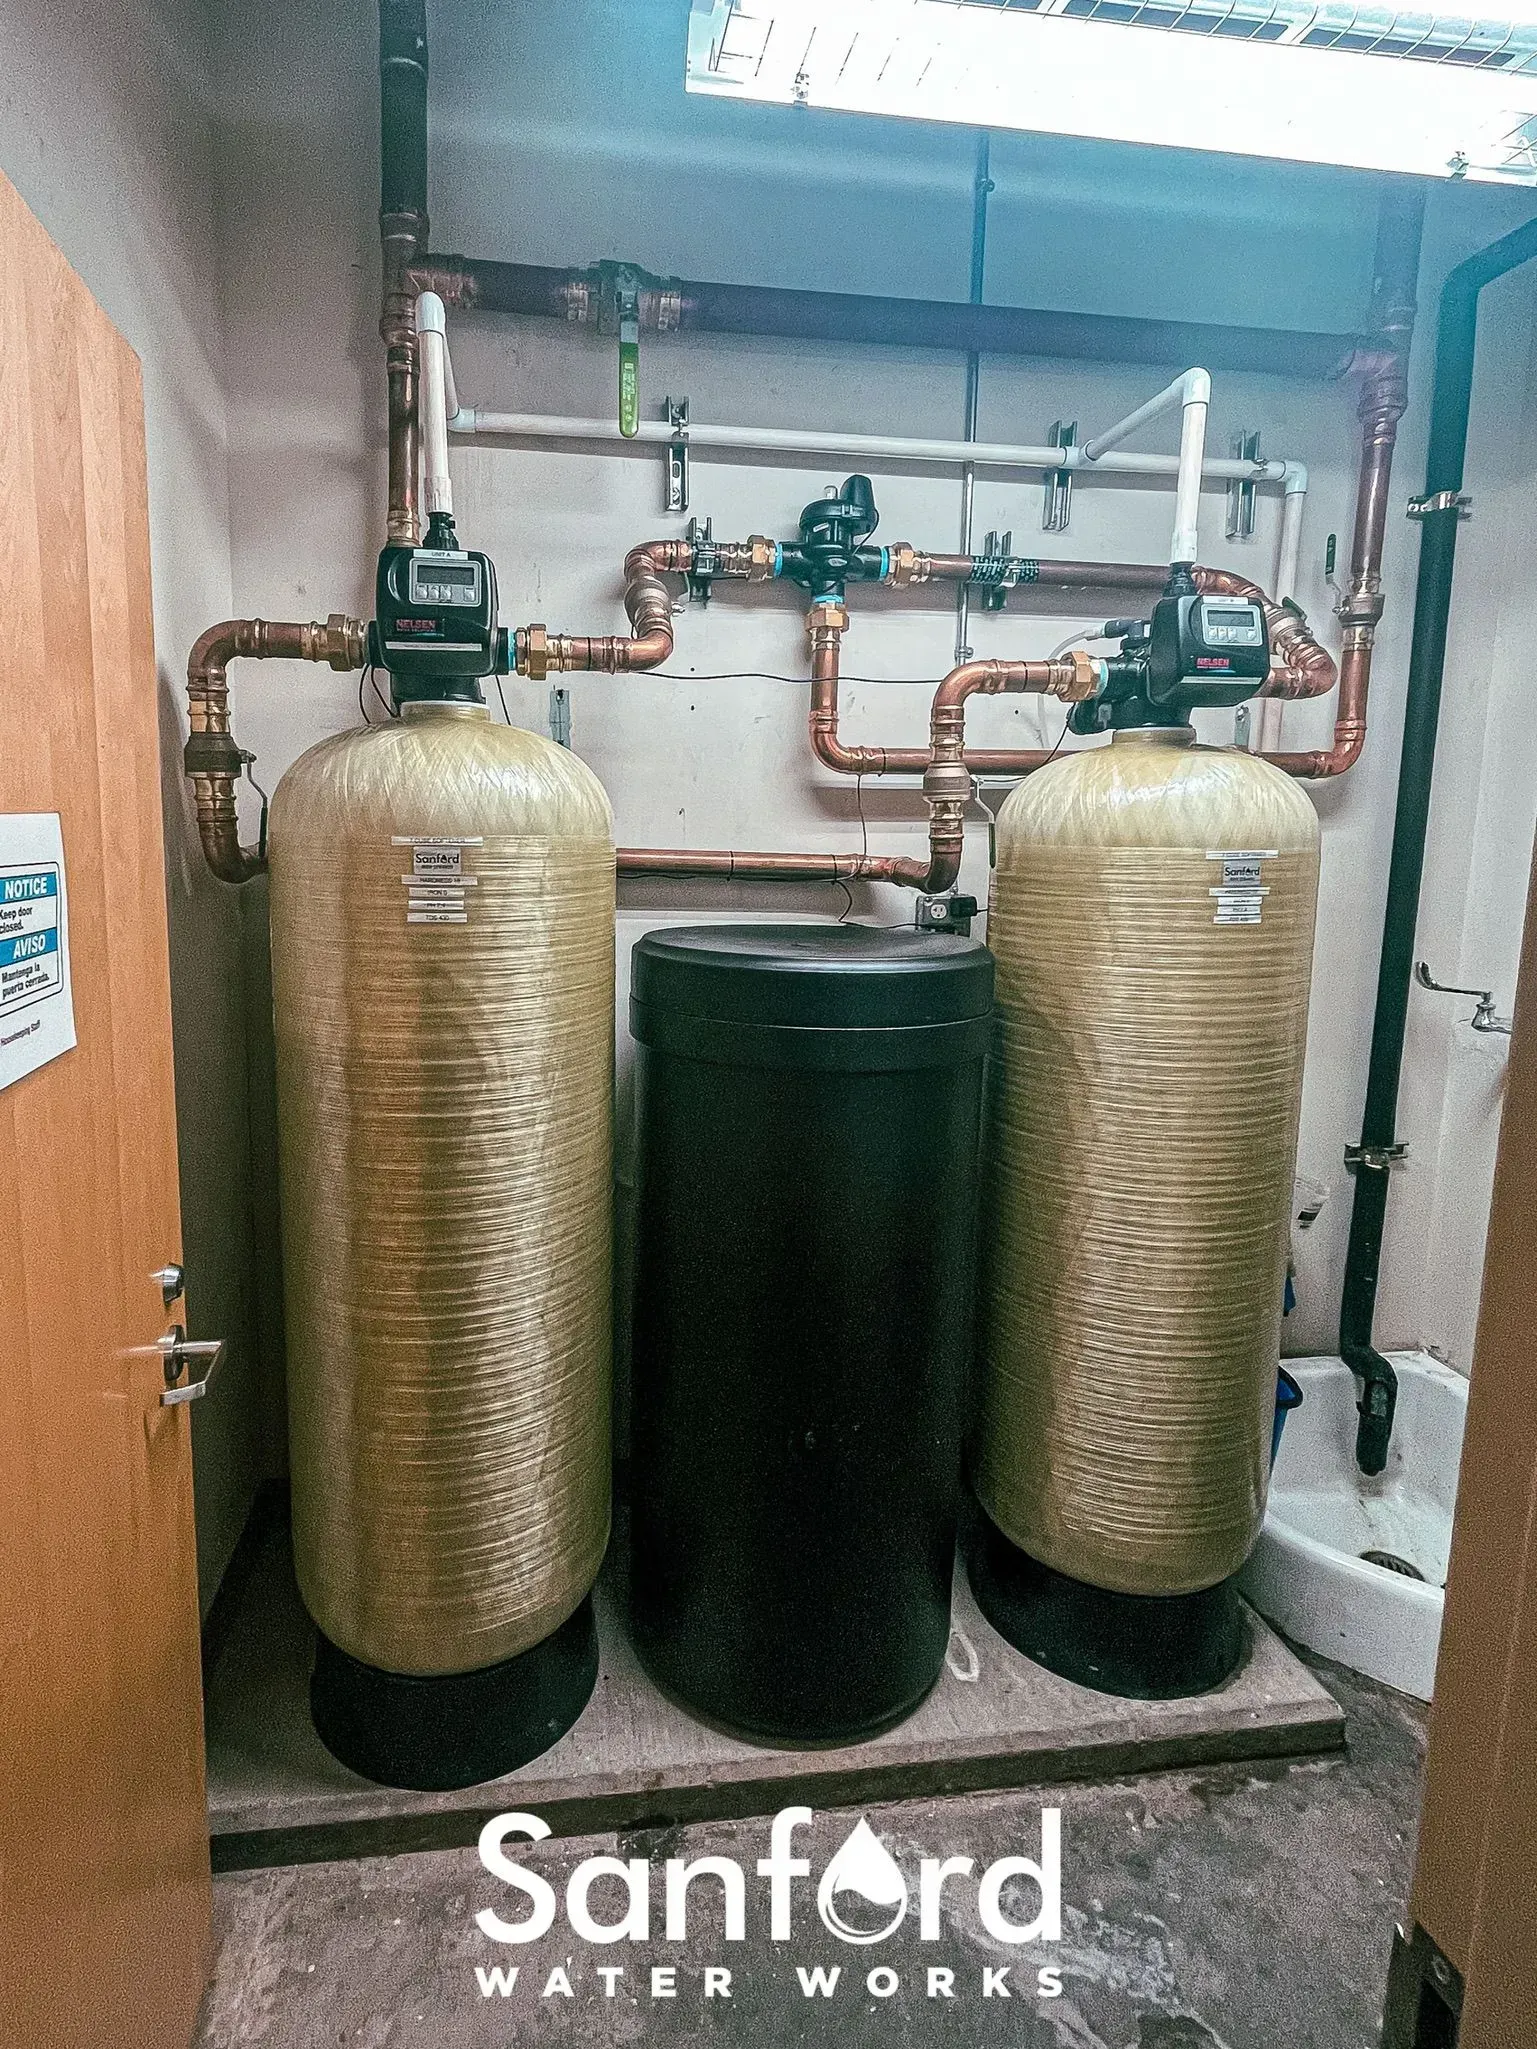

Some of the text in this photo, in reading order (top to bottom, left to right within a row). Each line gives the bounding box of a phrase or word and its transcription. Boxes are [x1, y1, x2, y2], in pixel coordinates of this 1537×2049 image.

[396, 619, 436, 629] NELSEN
[1196, 657, 1230, 667] NELSEN
[415, 853, 460, 864] Sanford
[1224, 866, 1260, 876] Sanford
[5, 877, 48, 900] NOTICE
[18, 906, 33, 917] door
[13, 934, 46, 960] AVISO
